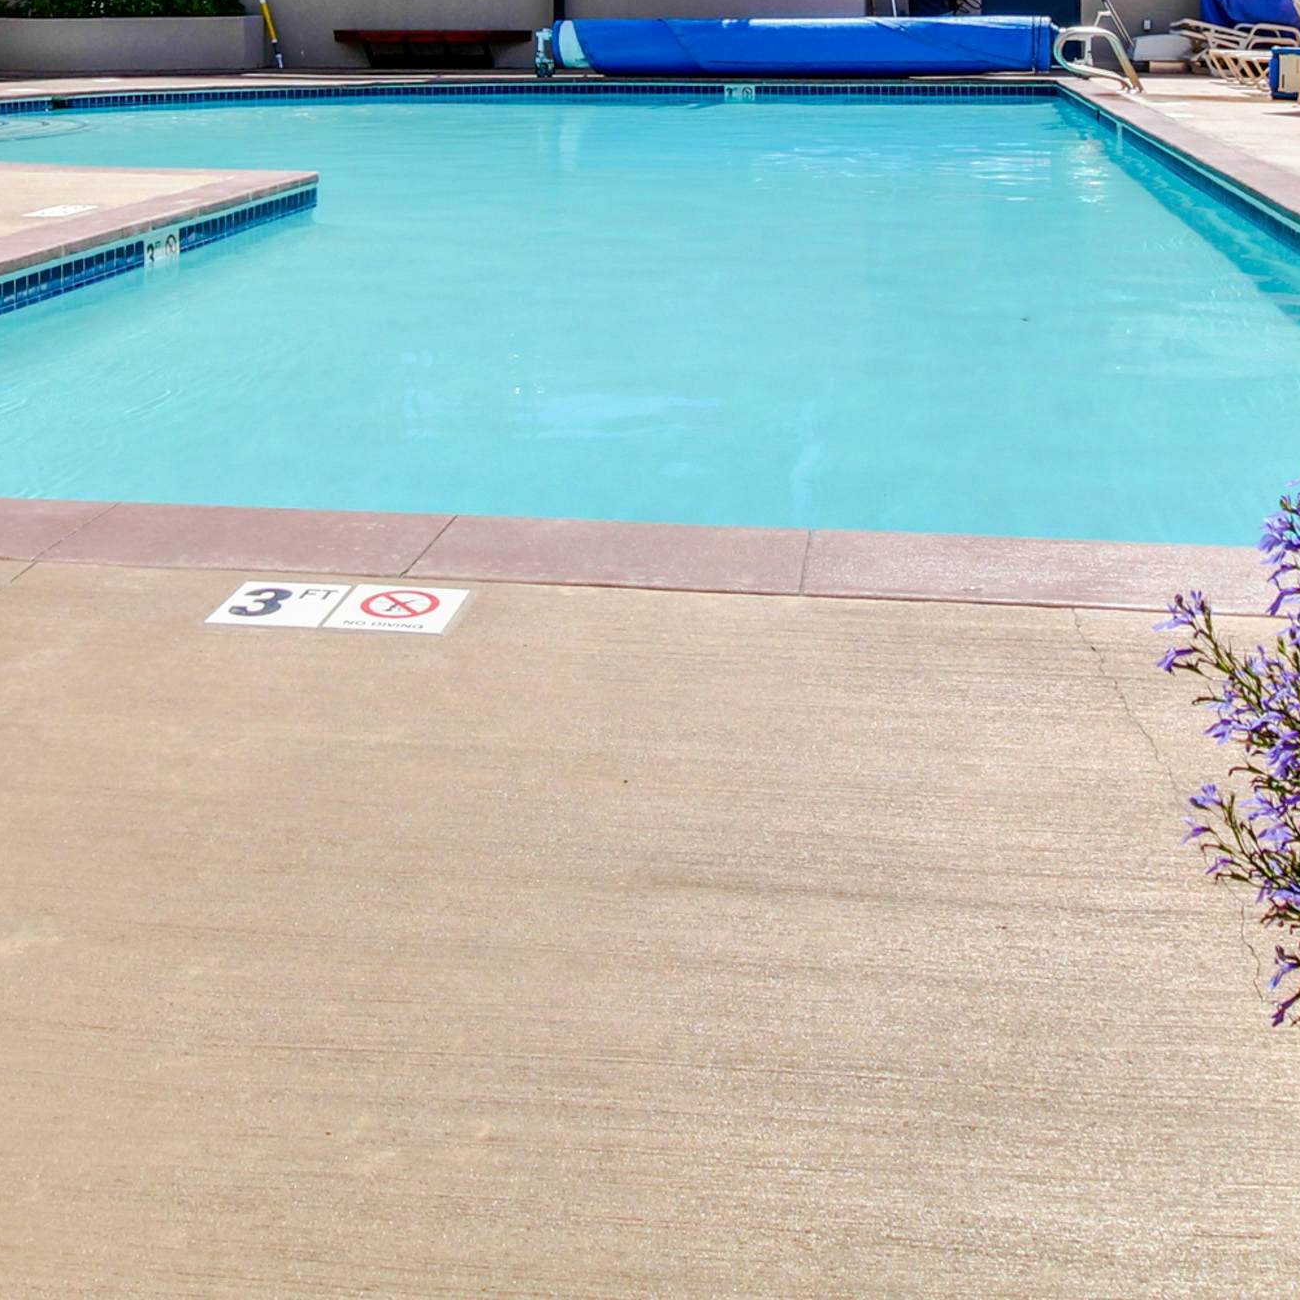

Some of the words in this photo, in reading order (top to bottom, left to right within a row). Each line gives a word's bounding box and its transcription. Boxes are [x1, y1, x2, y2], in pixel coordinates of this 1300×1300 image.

[228, 588, 292, 617] 3
[299, 588, 340, 601] FT
[371, 621, 424, 629] DIVING
